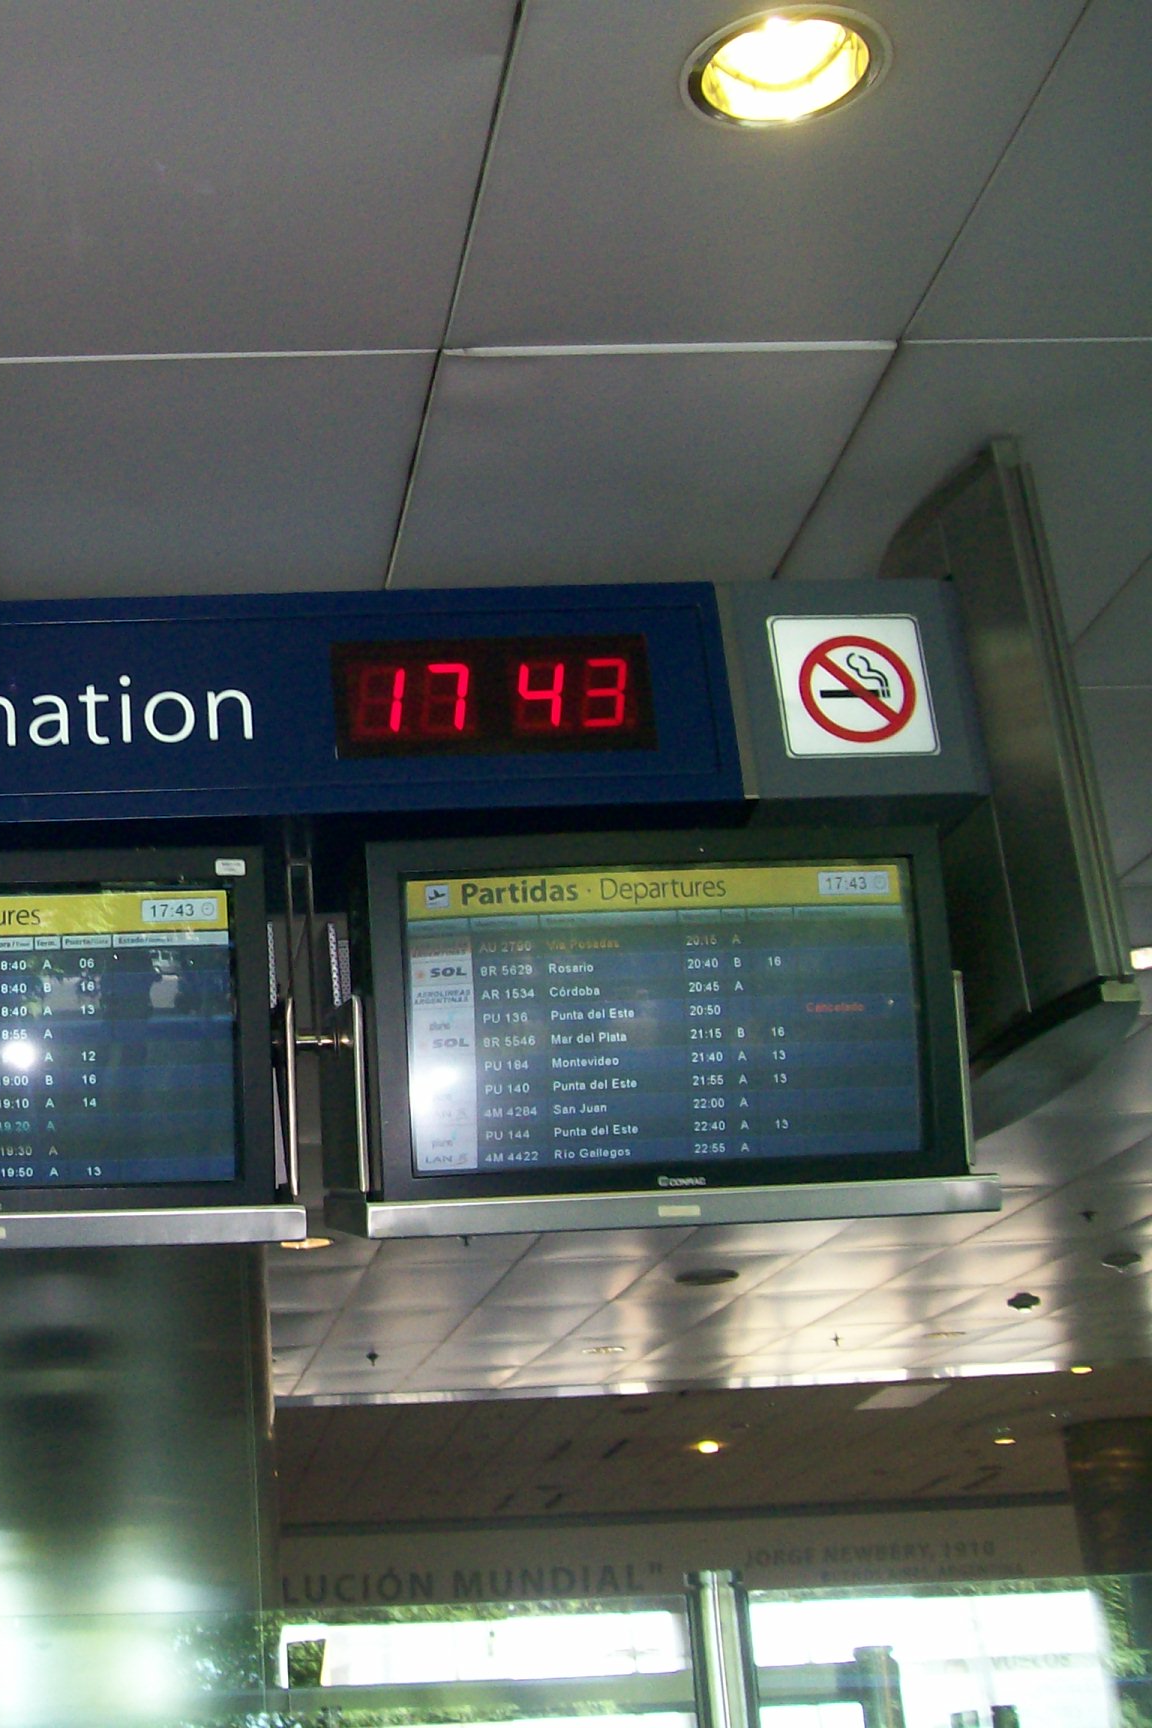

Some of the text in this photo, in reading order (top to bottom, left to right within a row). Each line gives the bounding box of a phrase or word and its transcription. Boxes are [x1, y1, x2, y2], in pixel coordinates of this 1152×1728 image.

[389, 659, 627, 732] 17 43
[461, 876, 868, 906] Partidas Departures 17:43
[150, 902, 195, 918] 17:43
[78, 957, 95, 969] 06
[547, 957, 720, 974] Rosario 20:40
[429, 966, 468, 978] SOL
[548, 981, 720, 998] Córdoba 20:45
[482, 1013, 501, 1024] PU
[504, 1012, 529, 1023] 136
[550, 1010, 585, 1022] Punta
[587, 1008, 607, 1021] del
[608, 1008, 635, 1020] Este
[688, 1005, 722, 1017] 20:50
[550, 1028, 723, 1045] Mar del Plata 21:15
[81, 1050, 97, 1062] 12
[484, 1051, 724, 1072] PU Montevideo 21:40
[81, 1073, 97, 1085] 16
[484, 1074, 725, 1095] PU 140 Punta del Este 21:55
[82, 1097, 97, 1108] 14
[552, 1097, 726, 1116] San Juan 22:00
[485, 1120, 726, 1141] PU 144 Punta del Este 22:40
[506, 1143, 726, 1162] 4422 Gallegos 22:55
[0, 1166, 34, 1178] 19:50
[86, 1165, 103, 1177] 13
